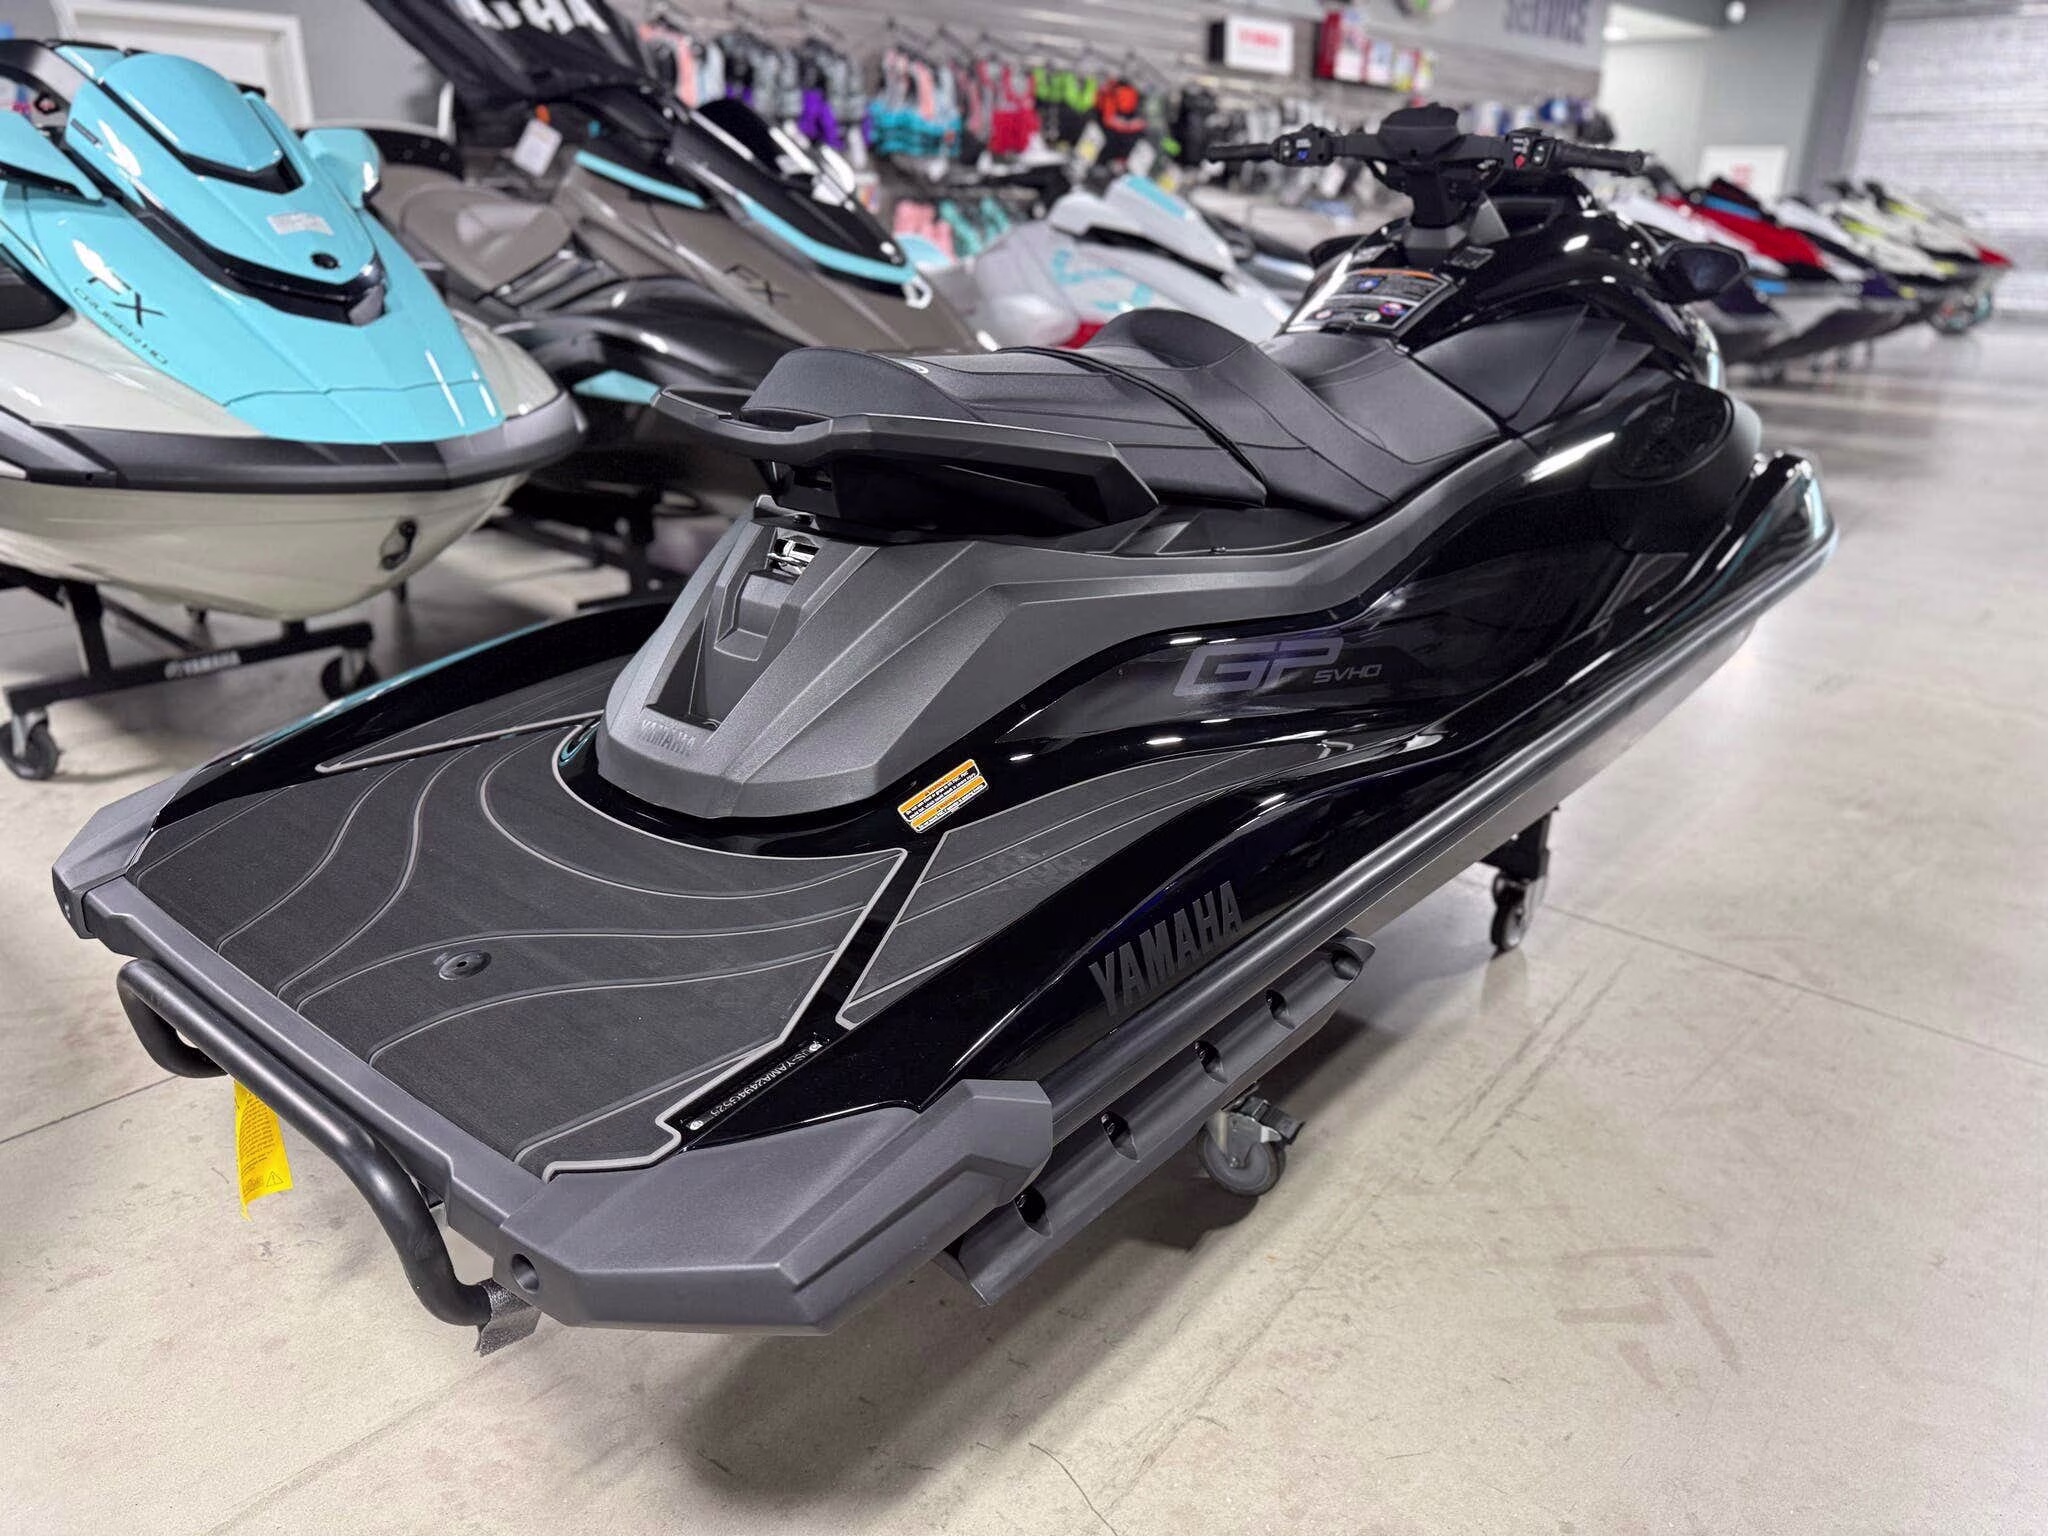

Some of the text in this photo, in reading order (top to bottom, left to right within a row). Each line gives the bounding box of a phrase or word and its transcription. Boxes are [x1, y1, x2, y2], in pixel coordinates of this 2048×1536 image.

[1172, 637, 1383, 697] GP SVHO
[640, 719, 698, 757] YAMAHA
[1088, 880, 1243, 1018] YAMAHA
